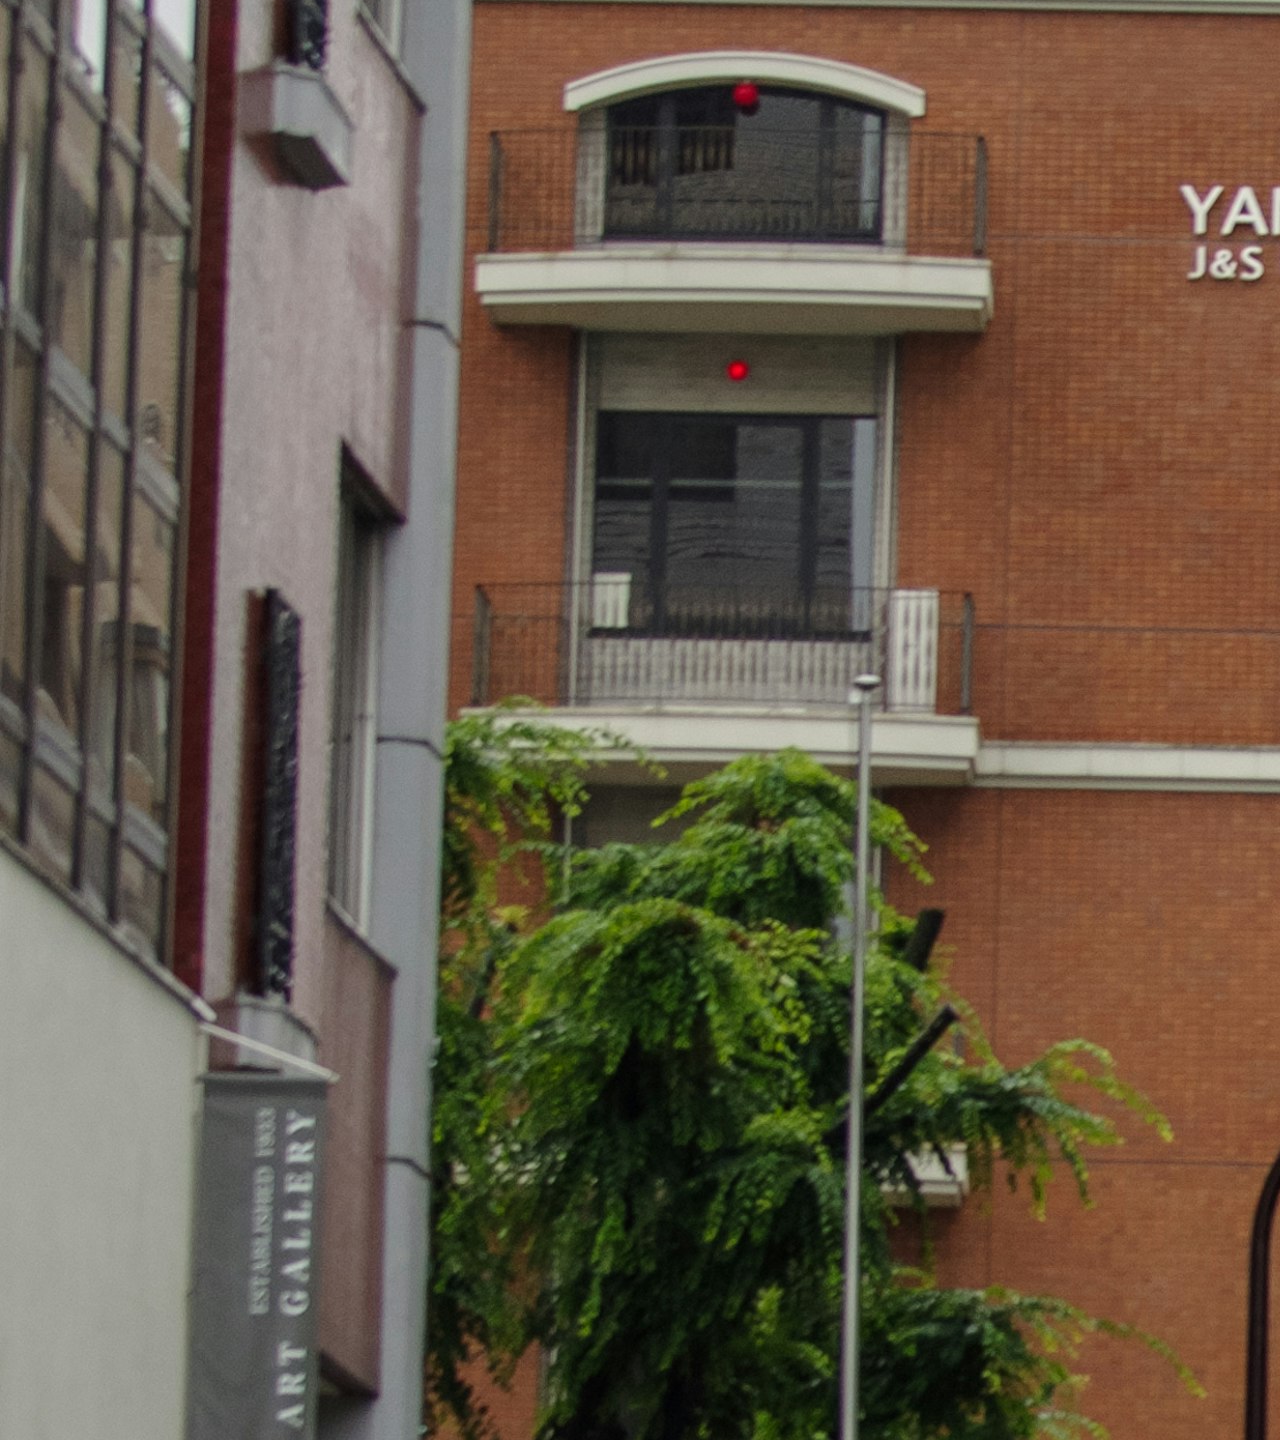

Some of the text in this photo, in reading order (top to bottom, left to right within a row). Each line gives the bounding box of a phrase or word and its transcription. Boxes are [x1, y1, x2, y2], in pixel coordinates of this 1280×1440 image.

[1186, 246, 1266, 281] J&S
[250, 1165, 276, 1315] ESTABLISHED
[279, 1109, 316, 1317] GALLERY
[275, 1339, 308, 1429] ART
